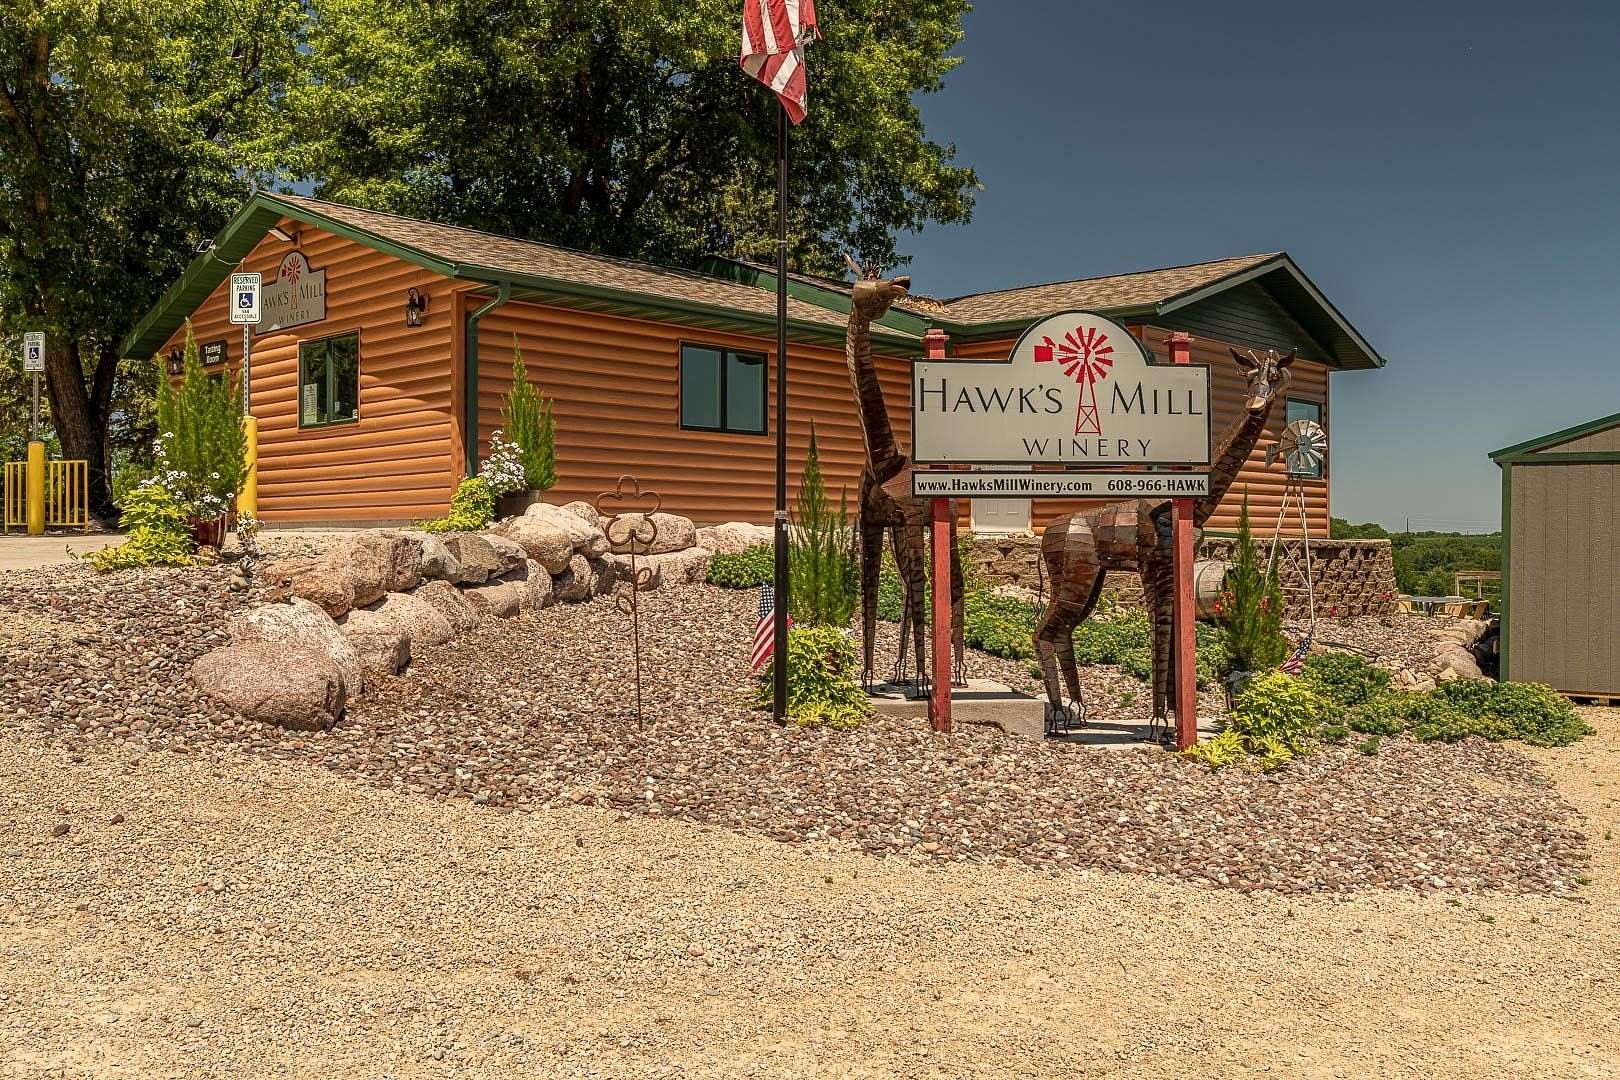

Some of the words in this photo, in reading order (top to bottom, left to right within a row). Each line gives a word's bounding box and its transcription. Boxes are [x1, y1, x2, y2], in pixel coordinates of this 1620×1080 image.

[233, 276, 259, 284] RESERVED
[236, 284, 256, 292] PARKING
[263, 291, 289, 311] AWK'S
[300, 283, 323, 299] MILL
[279, 310, 310, 323] WINERY
[205, 344, 221, 354] Tasting
[206, 355, 220, 363] Room
[919, 378, 1063, 414] HAWK'S
[1110, 381, 1203, 415] MILL
[1022, 438, 1151, 457] WINERY
[917, 479, 1092, 494] www.HawksMillWinery.com
[1107, 480, 1206, 492] 608-966-HAWK
